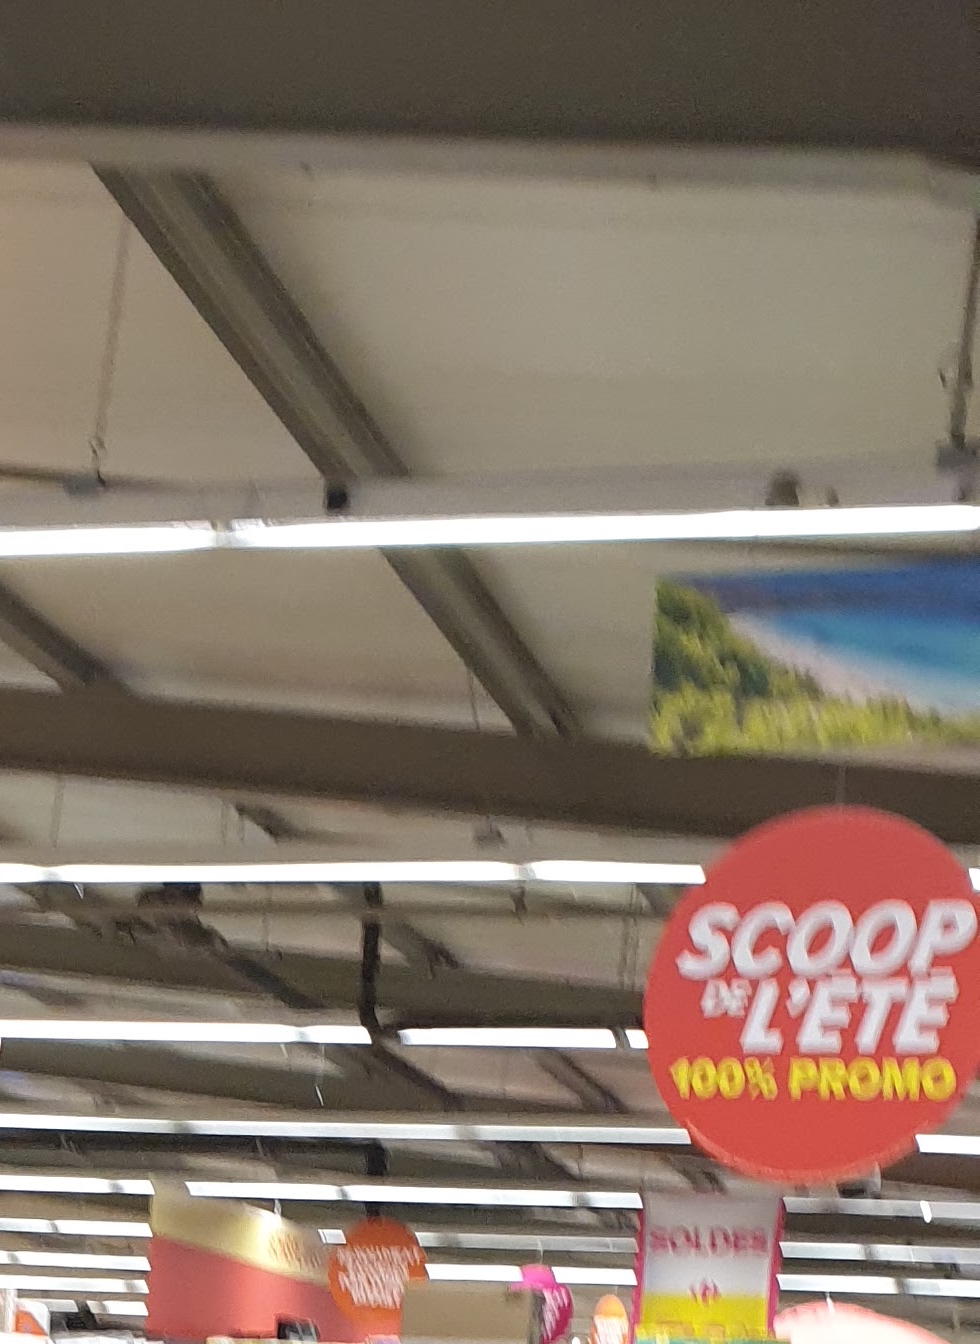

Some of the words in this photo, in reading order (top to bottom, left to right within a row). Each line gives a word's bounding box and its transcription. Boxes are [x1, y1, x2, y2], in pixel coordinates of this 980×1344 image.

[675, 899, 978, 980] SCOOP
[670, 1056, 778, 1100] 100%
[788, 1056, 957, 1102] PROMO
